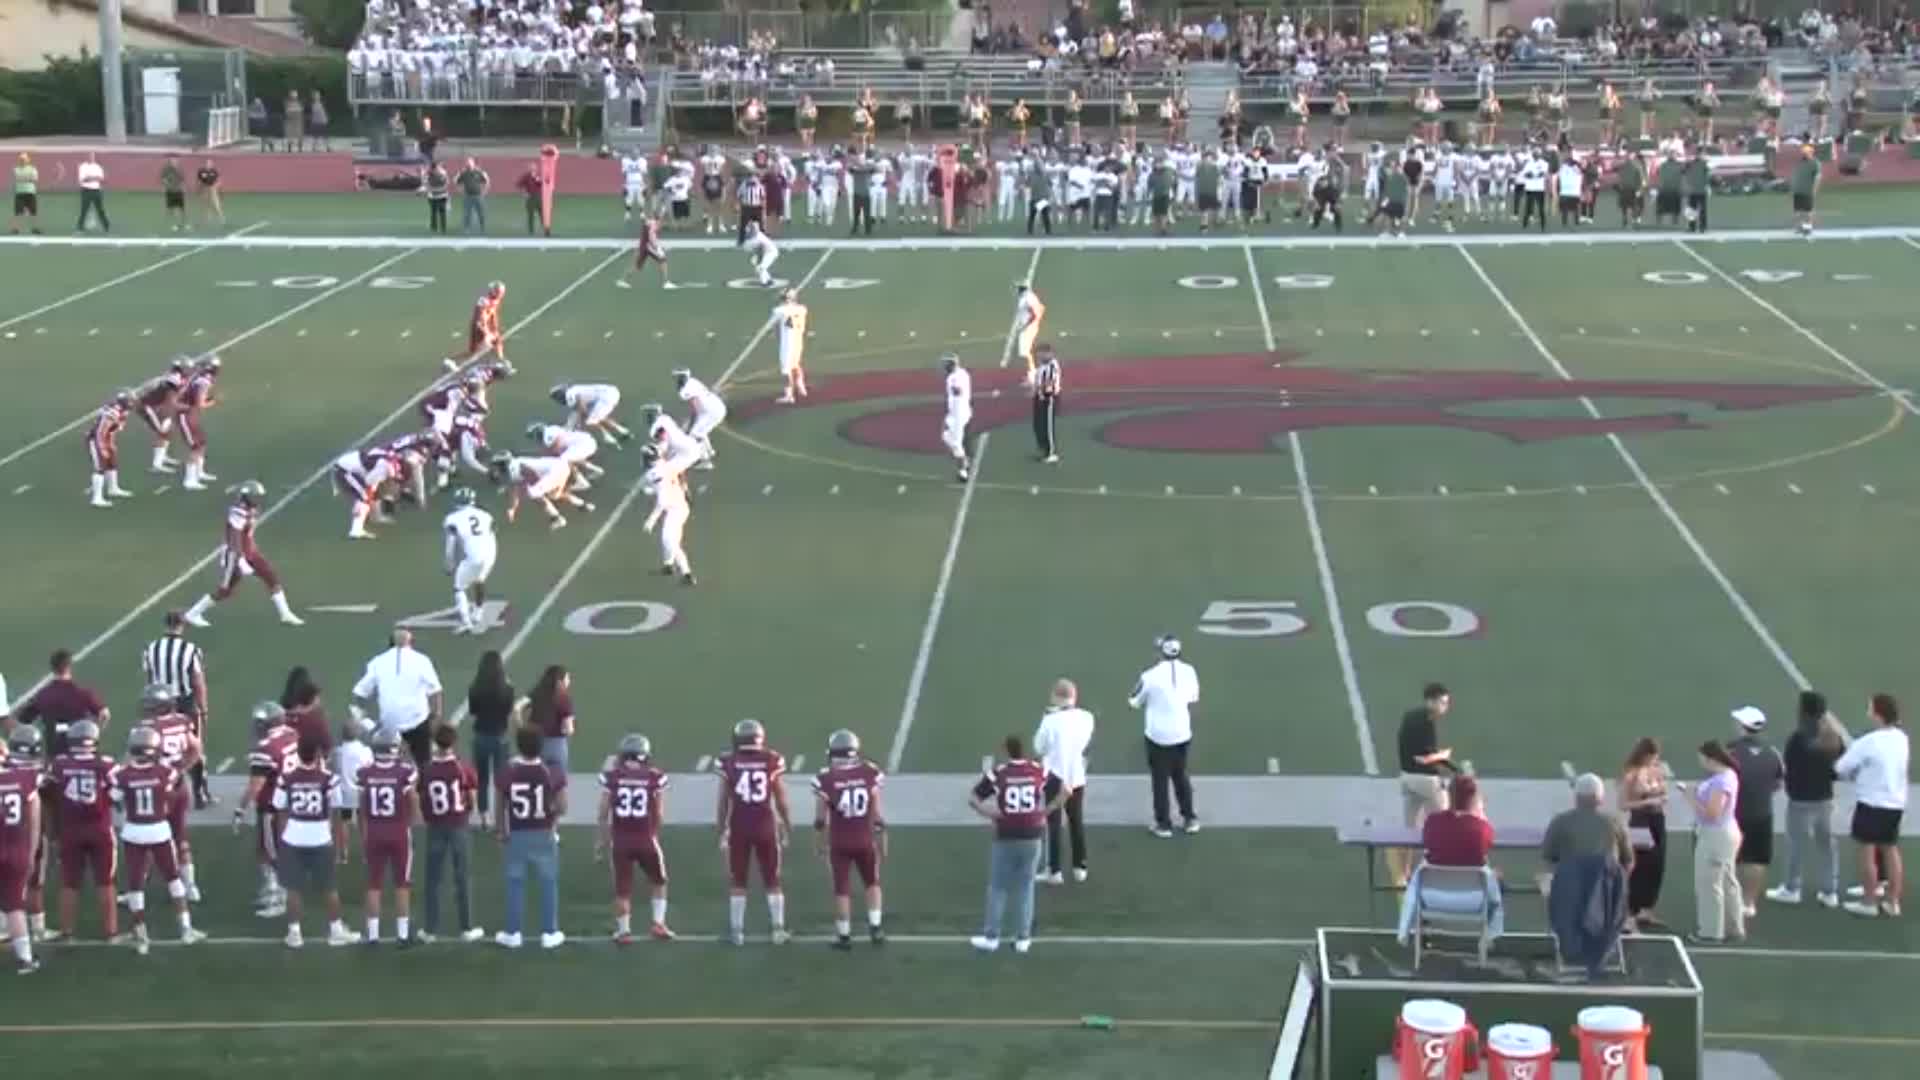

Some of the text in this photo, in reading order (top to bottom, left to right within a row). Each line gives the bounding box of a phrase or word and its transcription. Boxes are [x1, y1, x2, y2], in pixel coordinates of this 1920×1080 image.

[468, 516, 482, 536] 2
[371, 786, 395, 816] 13
[429, 779, 465, 815] 81
[511, 782, 546, 819] 51
[736, 770, 767, 803] 43
[1005, 785, 1035, 813] 95
[136, 787, 154, 816] 11
[292, 790, 323, 815] 28
[616, 787, 648, 817] 33
[838, 787, 868, 818] 40
[1425, 1039, 1445, 1059] G
[1604, 1044, 1624, 1066] G
